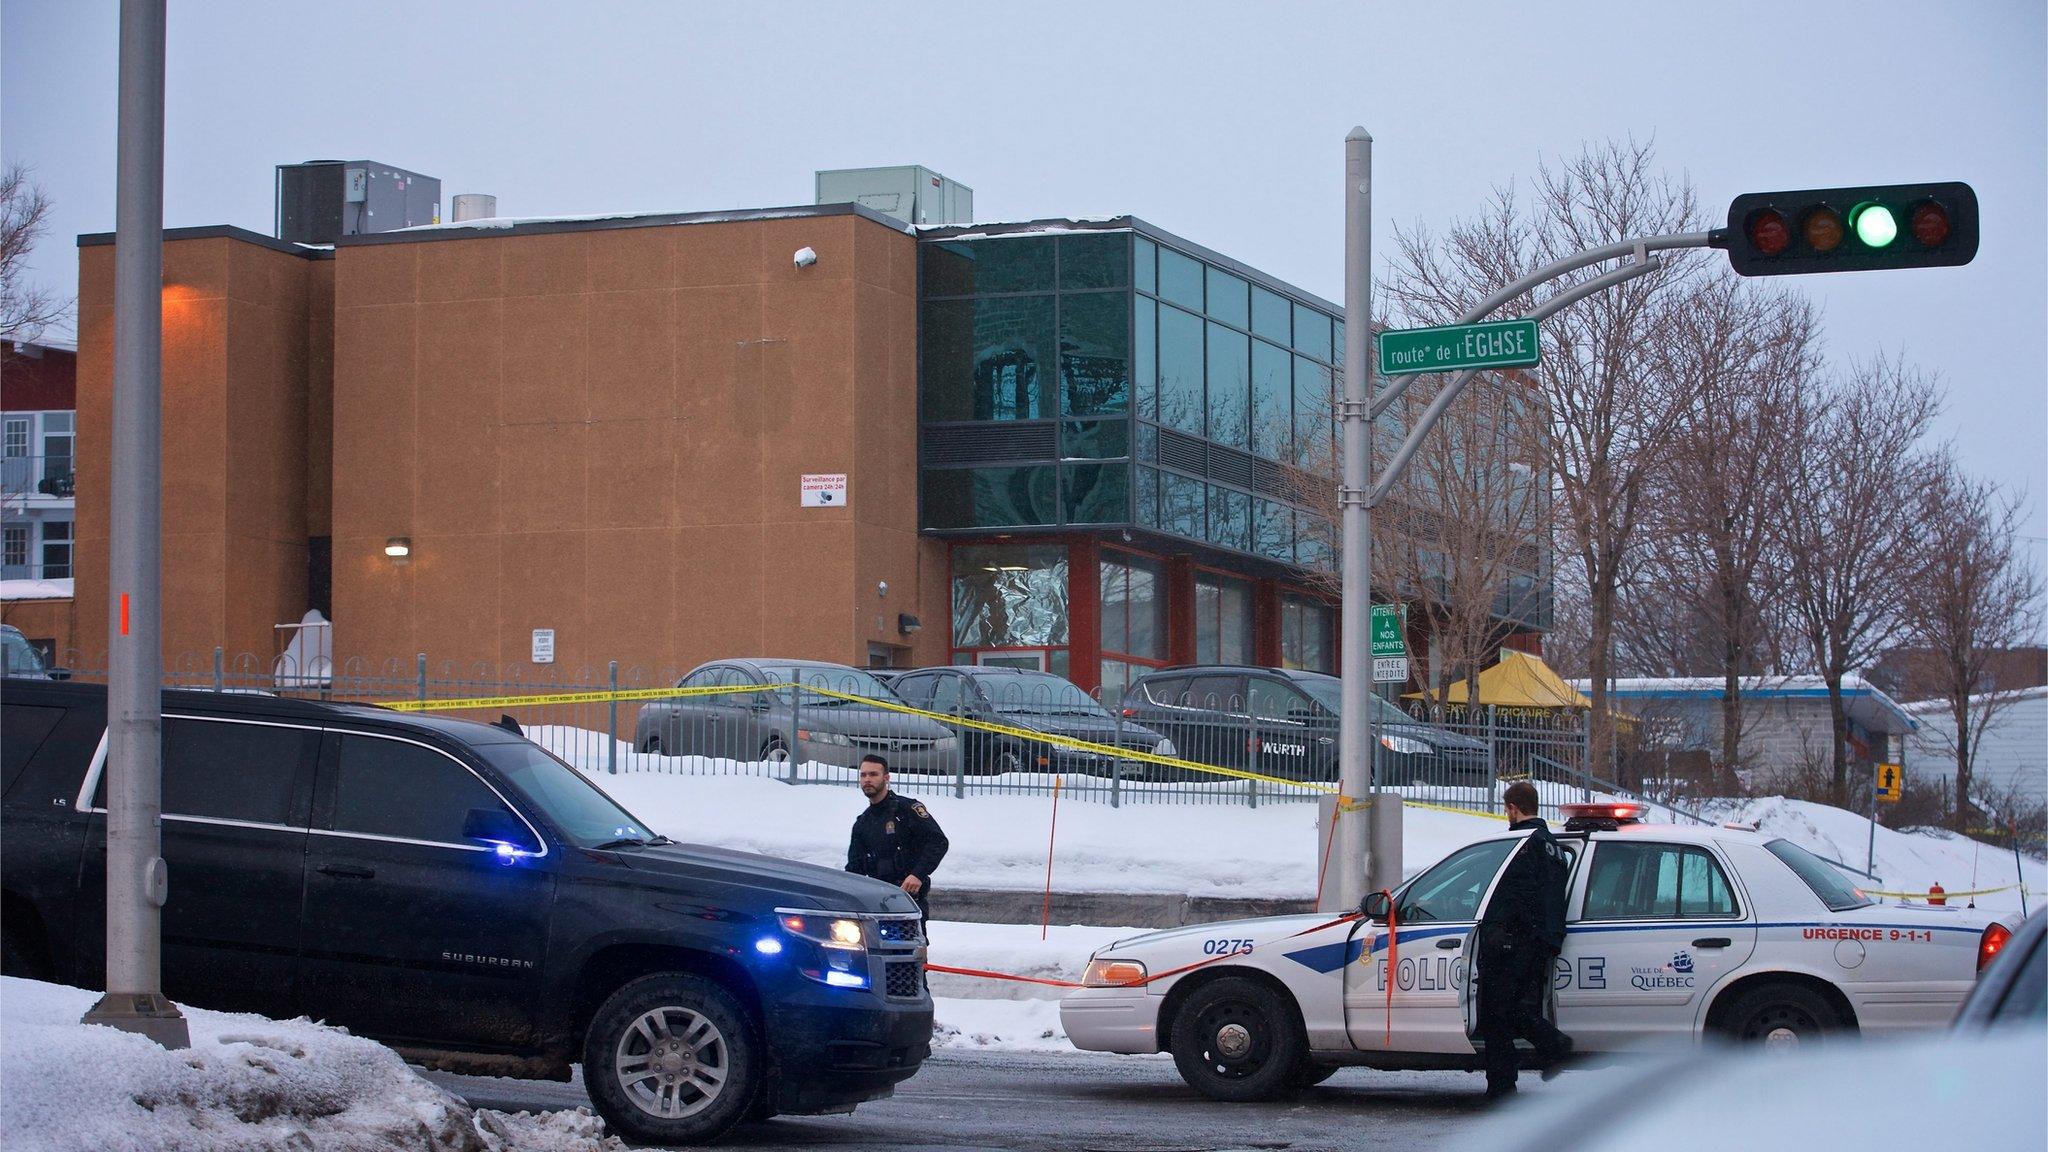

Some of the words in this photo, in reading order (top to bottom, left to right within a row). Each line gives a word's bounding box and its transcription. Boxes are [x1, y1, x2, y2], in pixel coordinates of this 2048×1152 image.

[1391, 346, 1425, 364] route
[1436, 345, 1450, 361] de
[1380, 630, 1395, 639] NOS
[1373, 641, 1404, 651] ENFANTS
[53, 798, 66, 806] LS
[1803, 928, 1883, 940] URGENCE
[1889, 929, 1932, 942] 9-1-1
[1203, 938, 1254, 955] 0275
[442, 952, 534, 969] SUBURBAN
